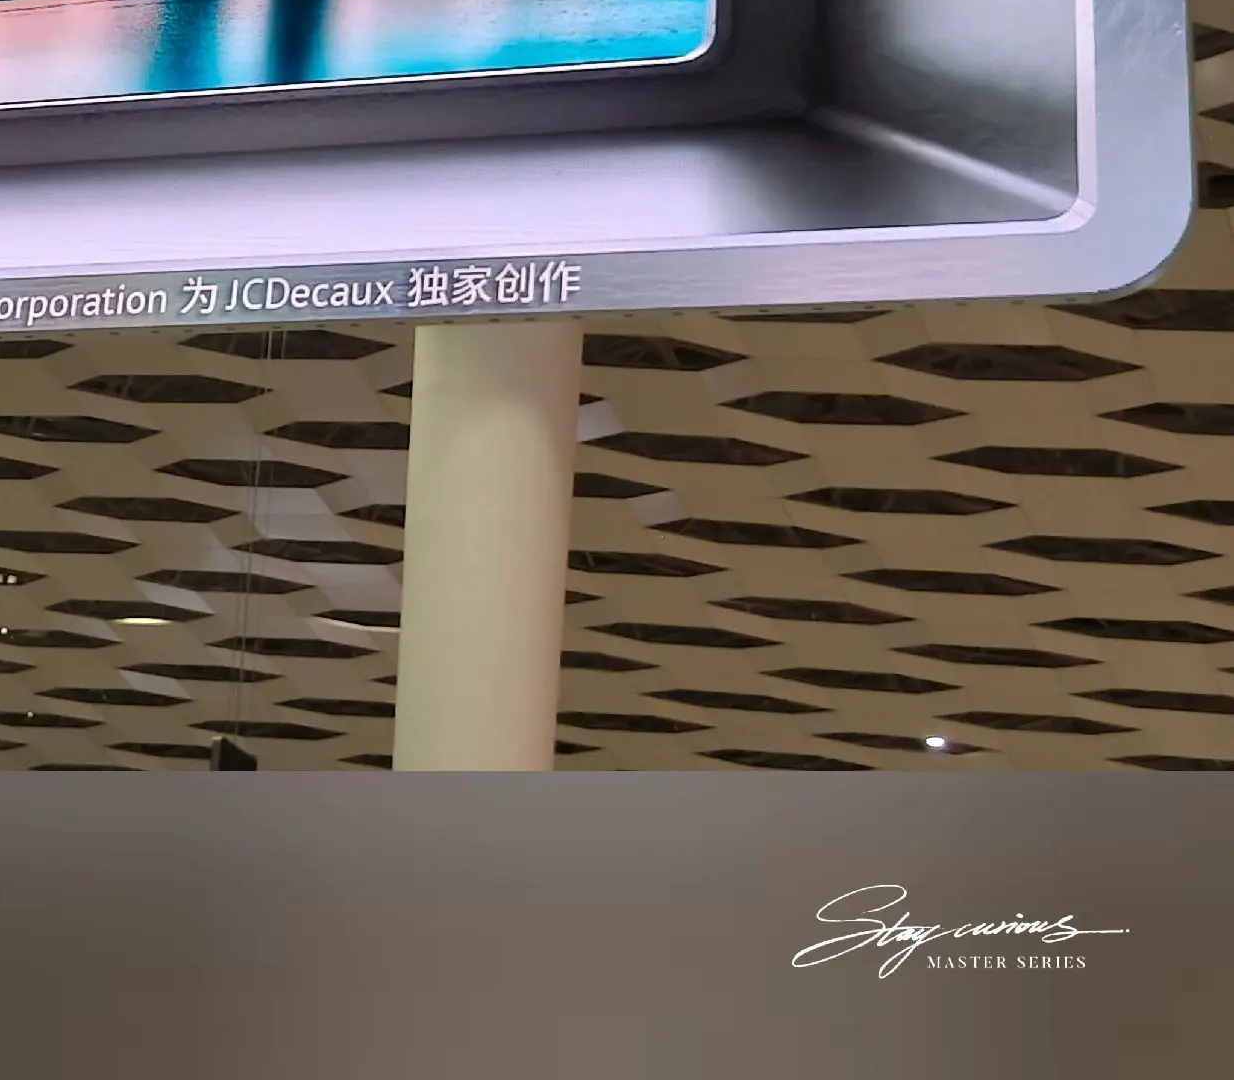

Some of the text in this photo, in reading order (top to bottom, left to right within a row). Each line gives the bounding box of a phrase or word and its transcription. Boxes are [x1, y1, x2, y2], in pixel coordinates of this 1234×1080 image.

[180, 276, 219, 315] 为
[225, 277, 394, 311] JCDecaux
[407, 261, 582, 308] 独家创作
